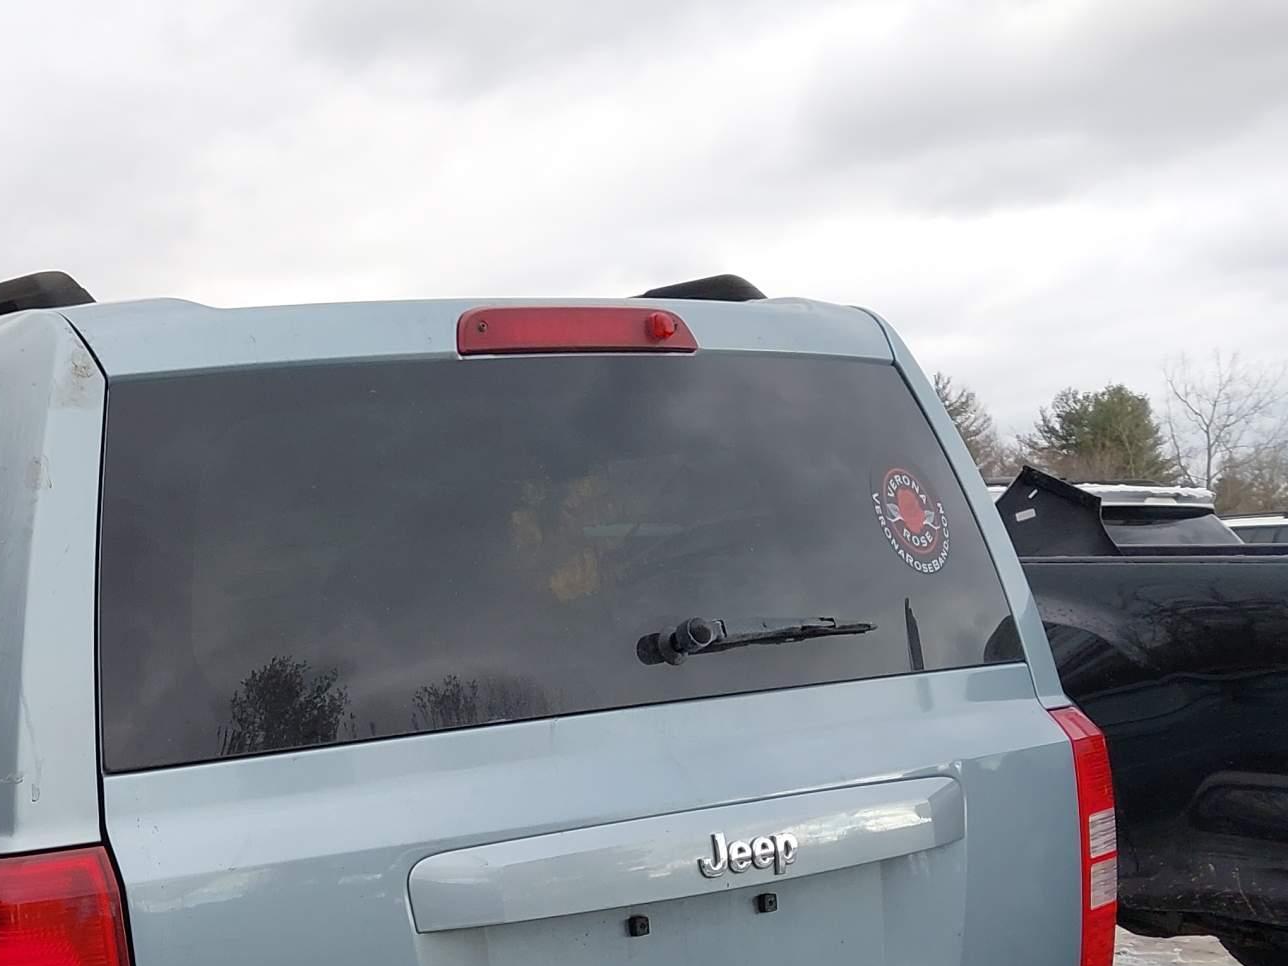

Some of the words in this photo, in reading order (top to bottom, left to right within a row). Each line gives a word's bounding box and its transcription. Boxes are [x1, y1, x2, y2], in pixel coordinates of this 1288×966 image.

[886, 474, 928, 504] VERONA
[903, 528, 934, 548] ROSE
[697, 832, 798, 878] Jeep
